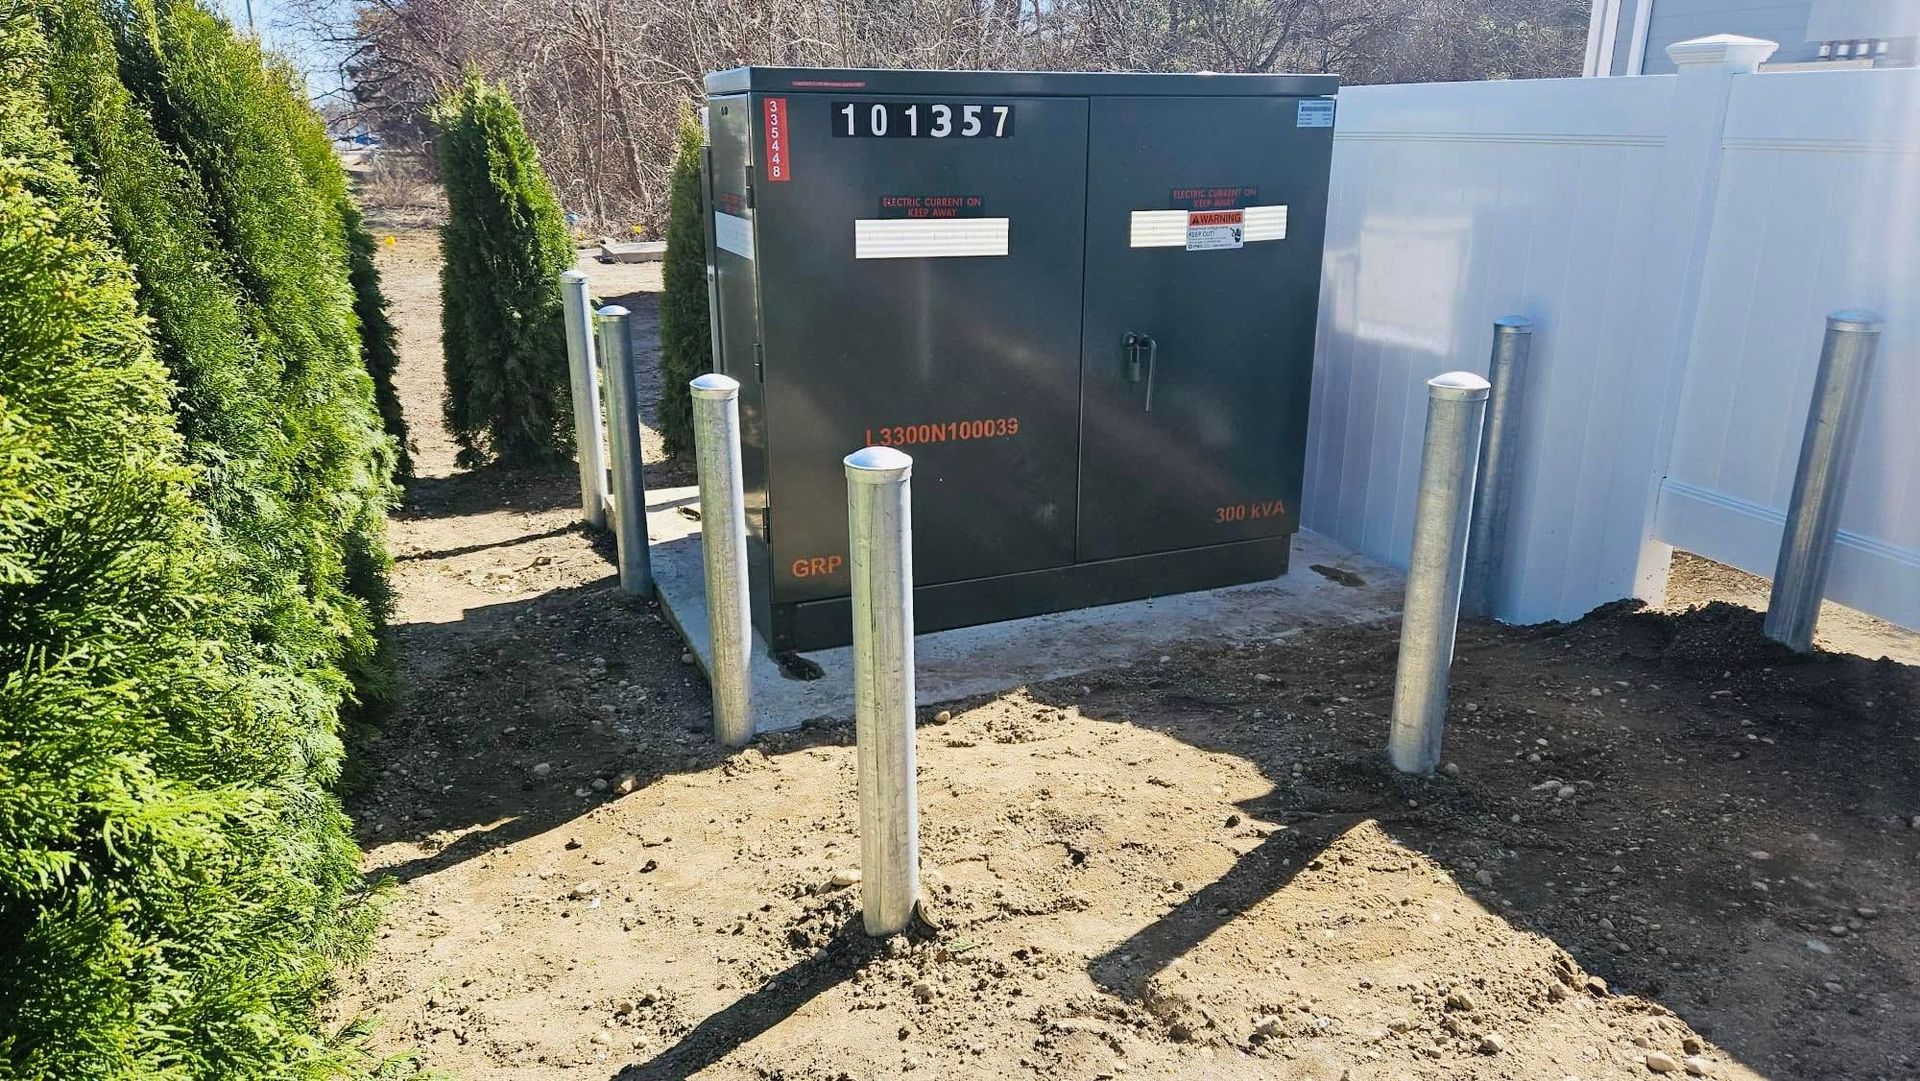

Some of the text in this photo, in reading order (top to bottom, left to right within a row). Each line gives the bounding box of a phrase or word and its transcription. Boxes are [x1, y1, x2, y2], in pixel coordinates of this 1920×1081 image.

[769, 101, 781, 177] 335448
[1173, 188, 1257, 199] ELECTRIC CURRENT ON
[883, 197, 981, 207] ELECTRIC CURRENT ON
[1194, 199, 1215, 208] KEEP
[908, 208, 957, 217] KEEP AWAY
[1200, 213, 1241, 224] WARNING
[866, 417, 1019, 447] L3300N100039
[1215, 500, 1285, 523] 300 kVA
[792, 555, 842, 577] GRP
